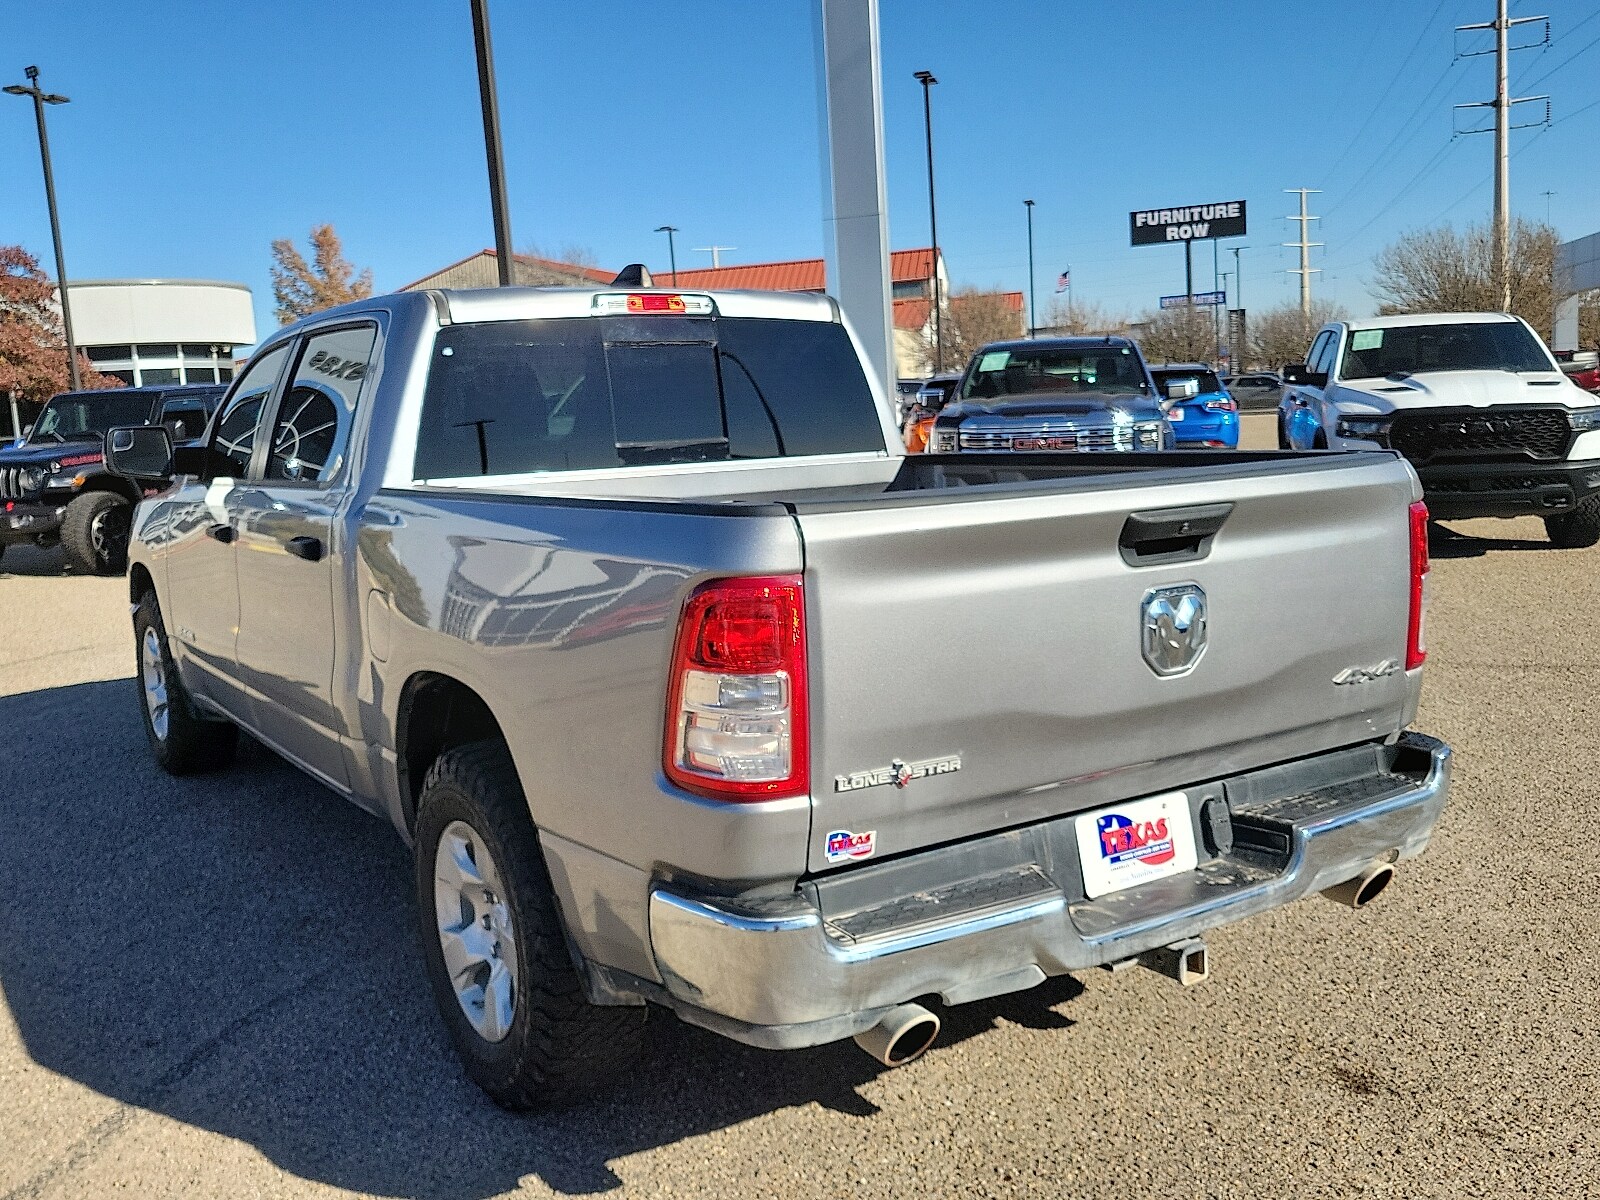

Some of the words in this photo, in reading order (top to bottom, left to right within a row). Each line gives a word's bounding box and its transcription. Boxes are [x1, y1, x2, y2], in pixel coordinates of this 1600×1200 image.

[1135, 203, 1241, 228] FURNITURE
[1165, 222, 1210, 241] ROW
[1014, 437, 1076, 451] GMC
[834, 768, 897, 793] LONE
[910, 756, 962, 780] STAR
[830, 832, 872, 852] TEXAS
[1101, 817, 1169, 855] TEXAS
